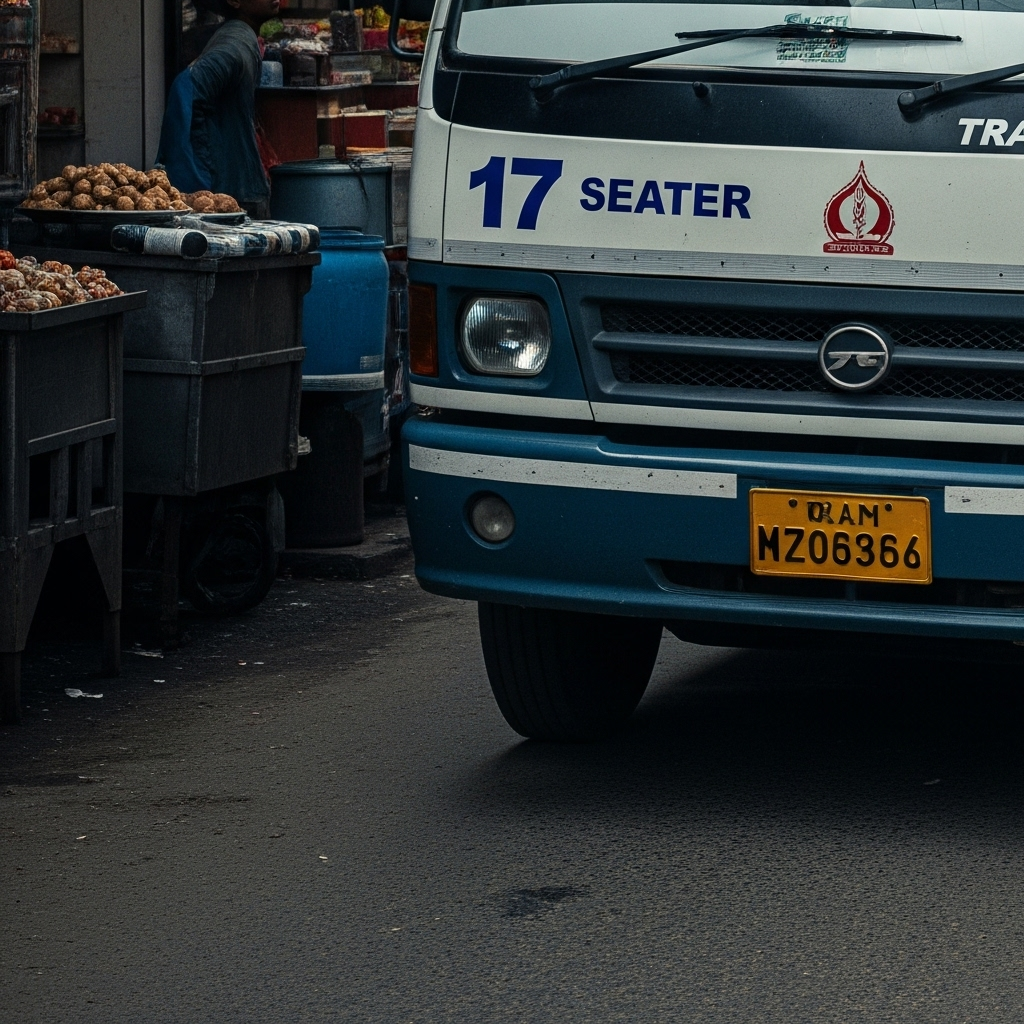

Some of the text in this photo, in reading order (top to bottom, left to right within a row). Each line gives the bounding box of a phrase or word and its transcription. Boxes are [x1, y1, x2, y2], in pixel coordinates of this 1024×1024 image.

[470, 156, 751, 231] 17 SEATER
[757, 524, 922, 570] MZ06366
